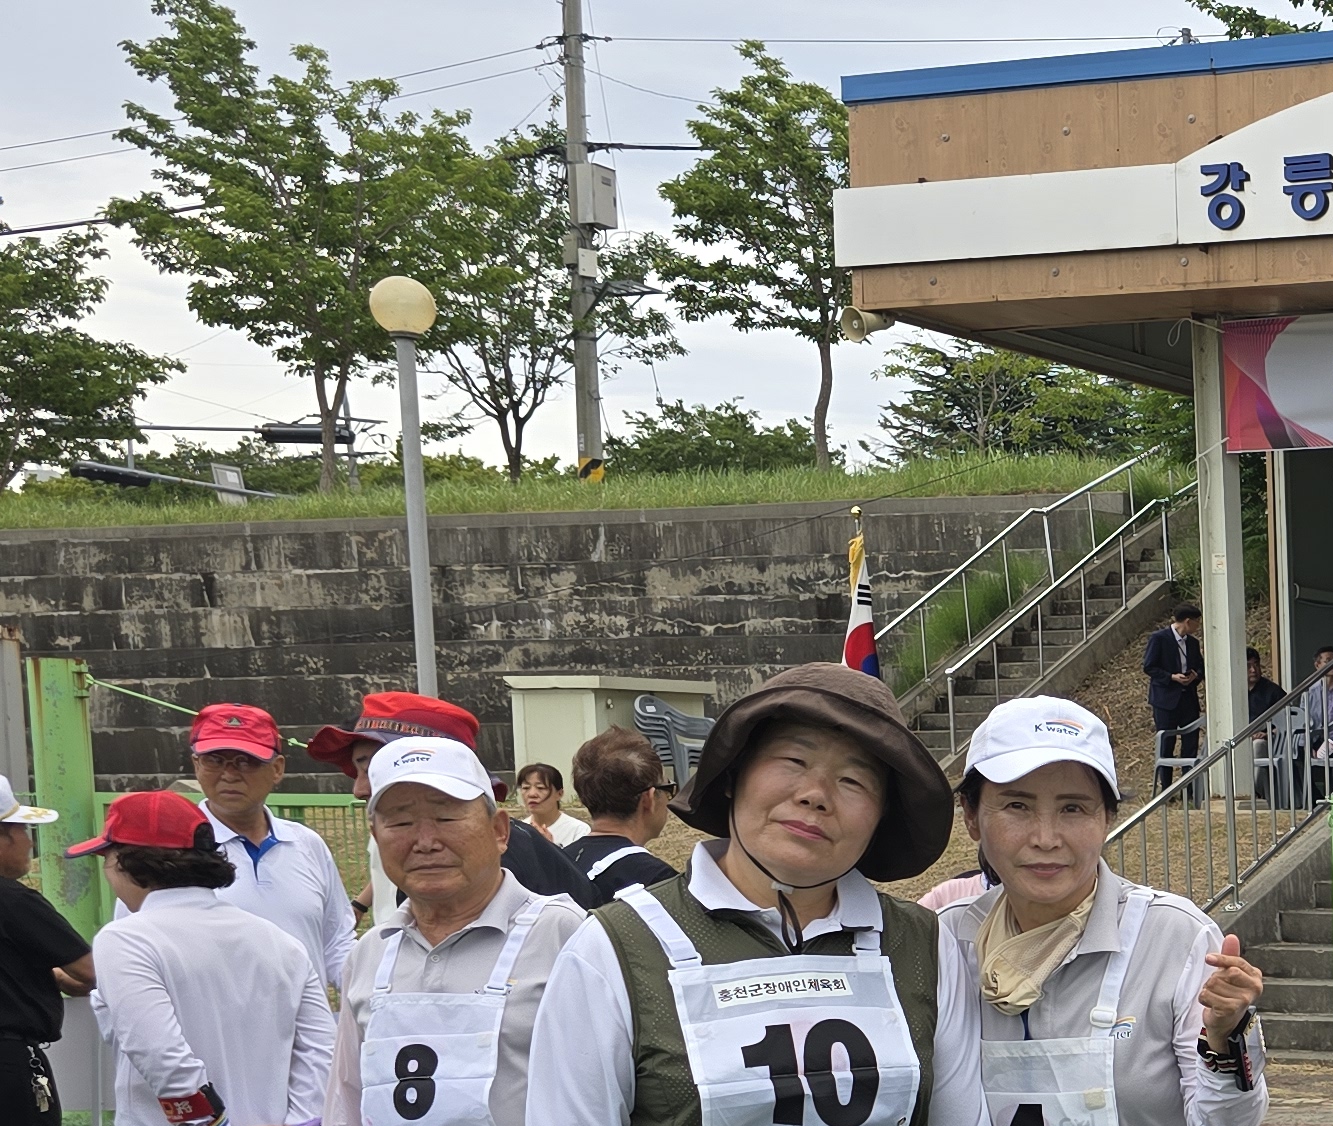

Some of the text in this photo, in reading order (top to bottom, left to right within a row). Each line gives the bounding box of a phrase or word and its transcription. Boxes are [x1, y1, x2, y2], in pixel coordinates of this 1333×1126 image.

[1046, 725, 1080, 737] water
[401, 755, 431, 765] water
[717, 977, 847, 1003] 홍천군장애인체육회
[393, 1043, 439, 1121] 8
